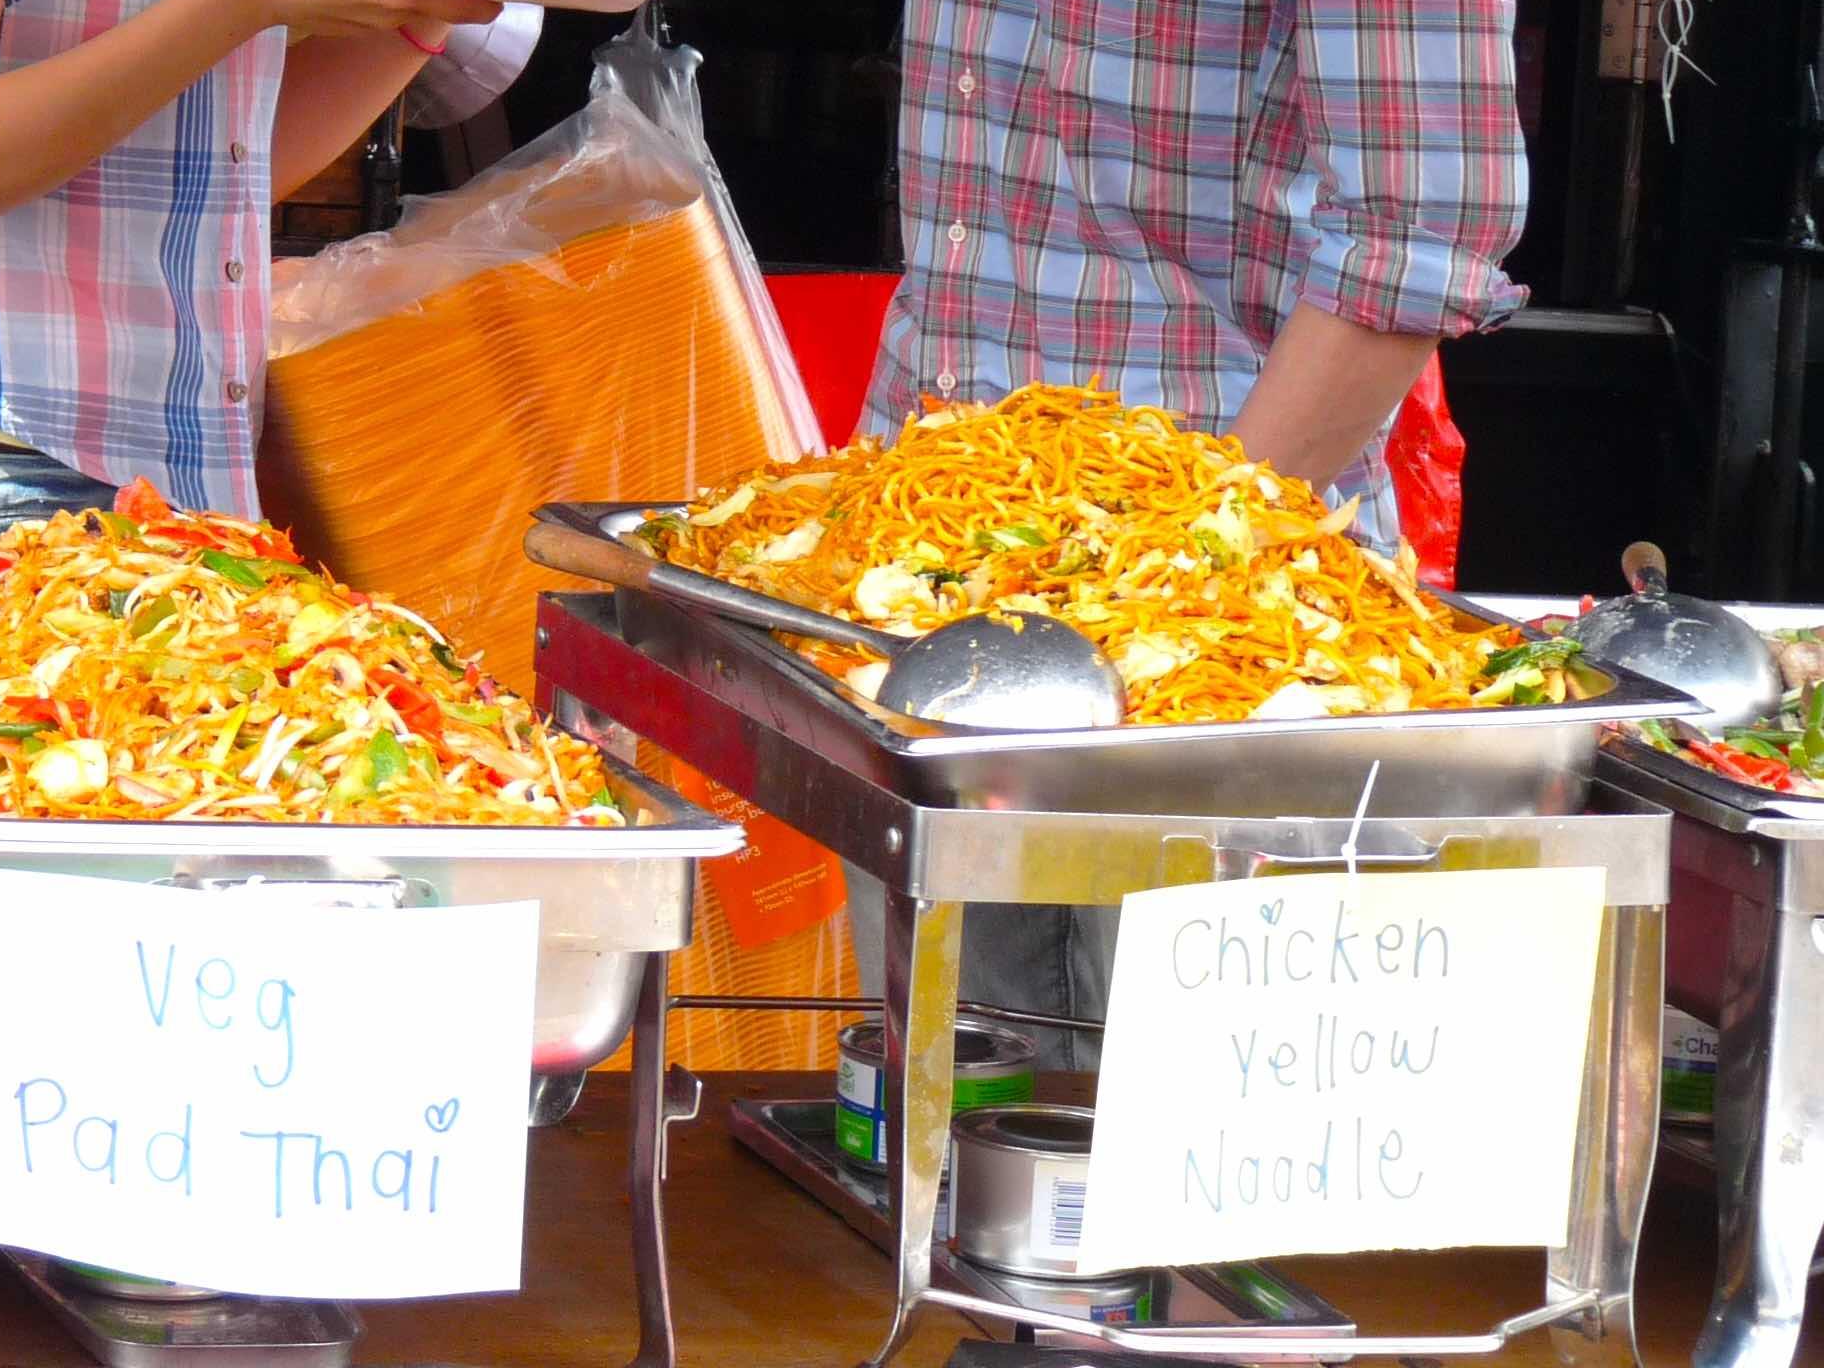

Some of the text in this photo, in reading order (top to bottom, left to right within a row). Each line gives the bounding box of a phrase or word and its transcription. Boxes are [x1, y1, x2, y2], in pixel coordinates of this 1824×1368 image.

[734, 845, 761, 864] HP3
[1172, 898, 1448, 990] Chicken
[135, 940, 296, 1088] Veg
[14, 1077, 460, 1219] Pad Thai
[1184, 1116, 1423, 1213] Noodle
